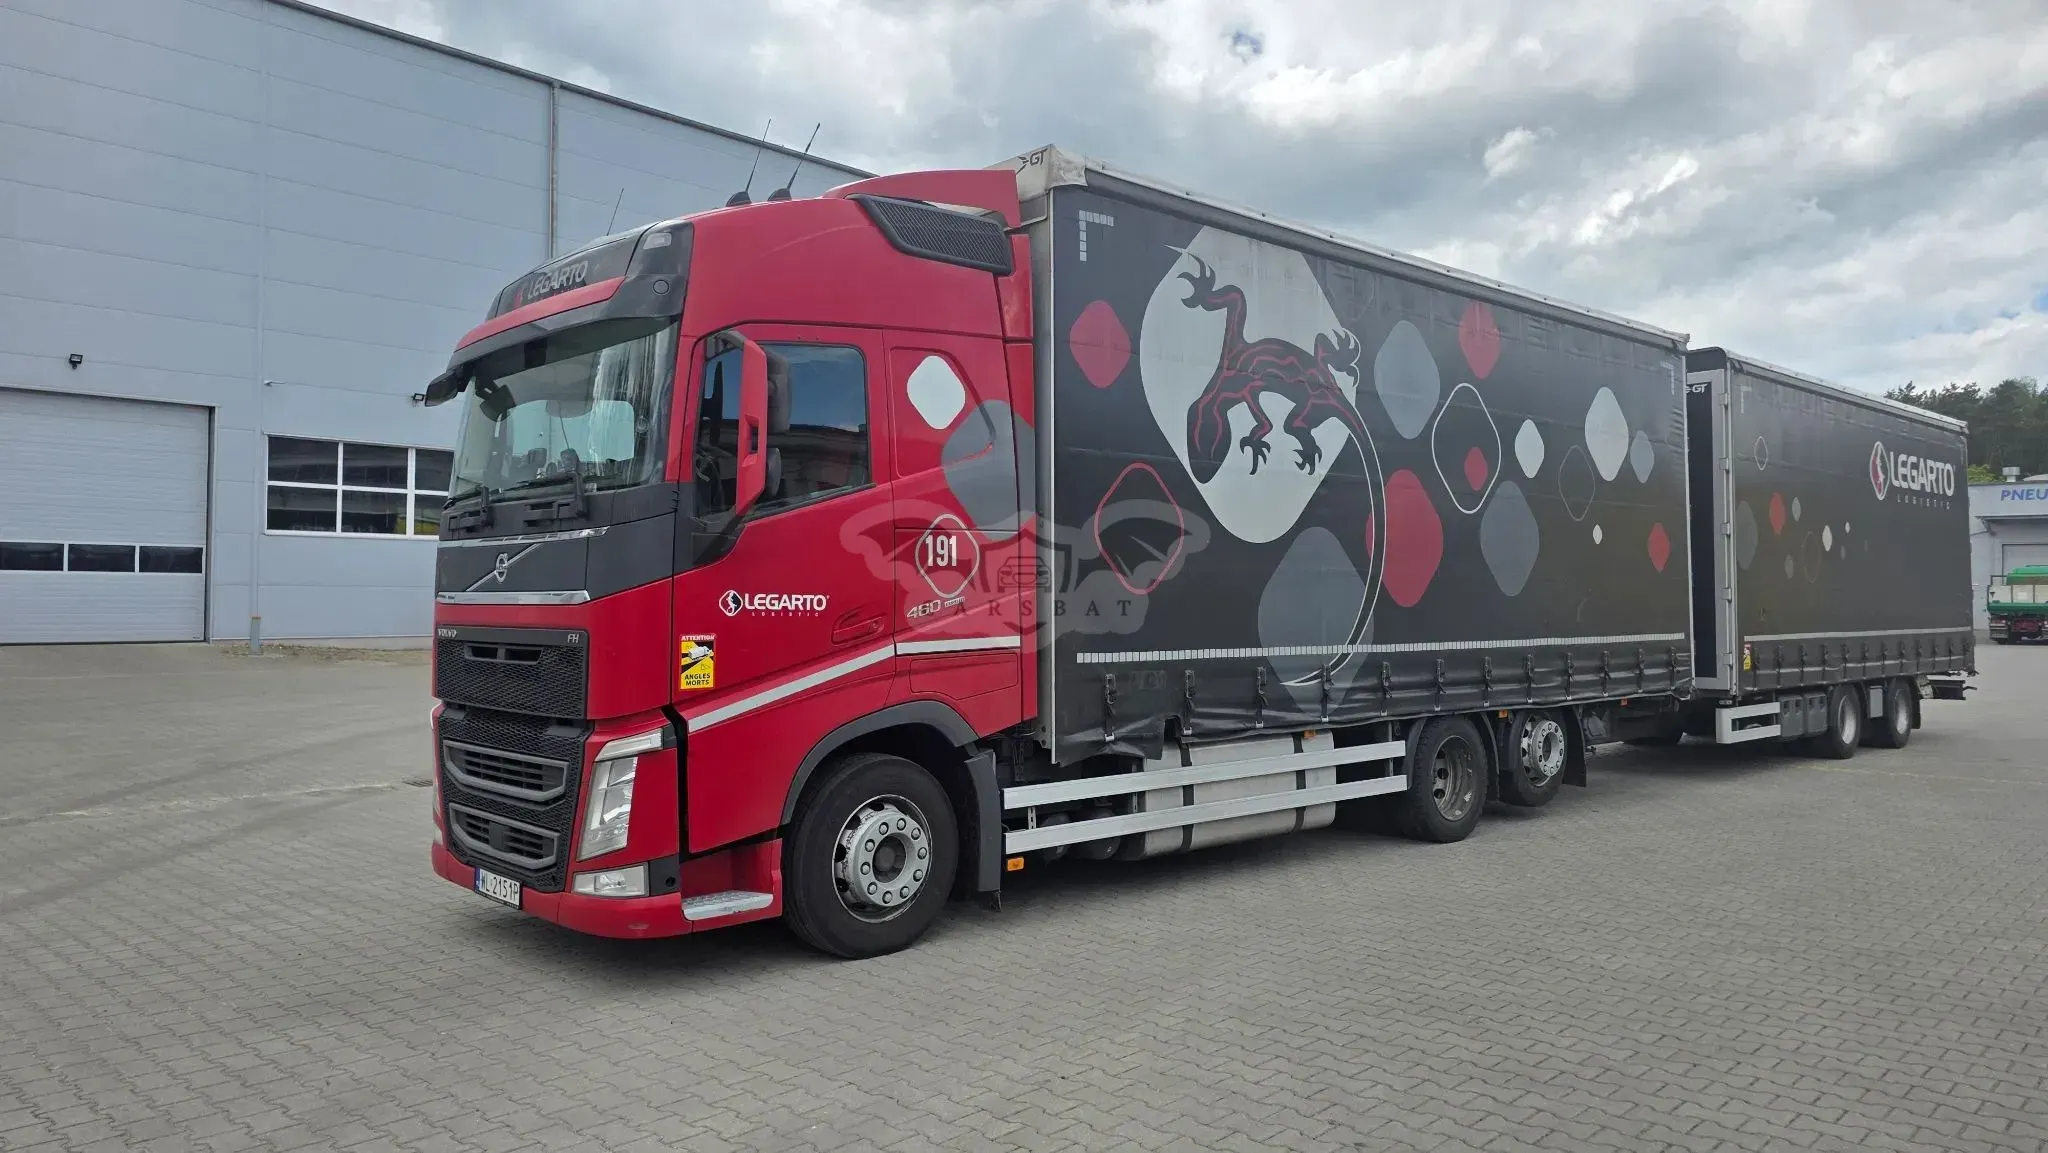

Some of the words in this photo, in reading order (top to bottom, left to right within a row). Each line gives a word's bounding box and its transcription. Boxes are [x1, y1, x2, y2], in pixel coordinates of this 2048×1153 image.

[527, 260, 588, 300] LEGARTO
[1890, 451, 1955, 497] LEGARTO
[926, 535, 957, 567] 191
[744, 593, 827, 611] LEGARTO
[907, 599, 941, 618] 460
[437, 628, 457, 638] VOLVO
[567, 634, 579, 644] FH
